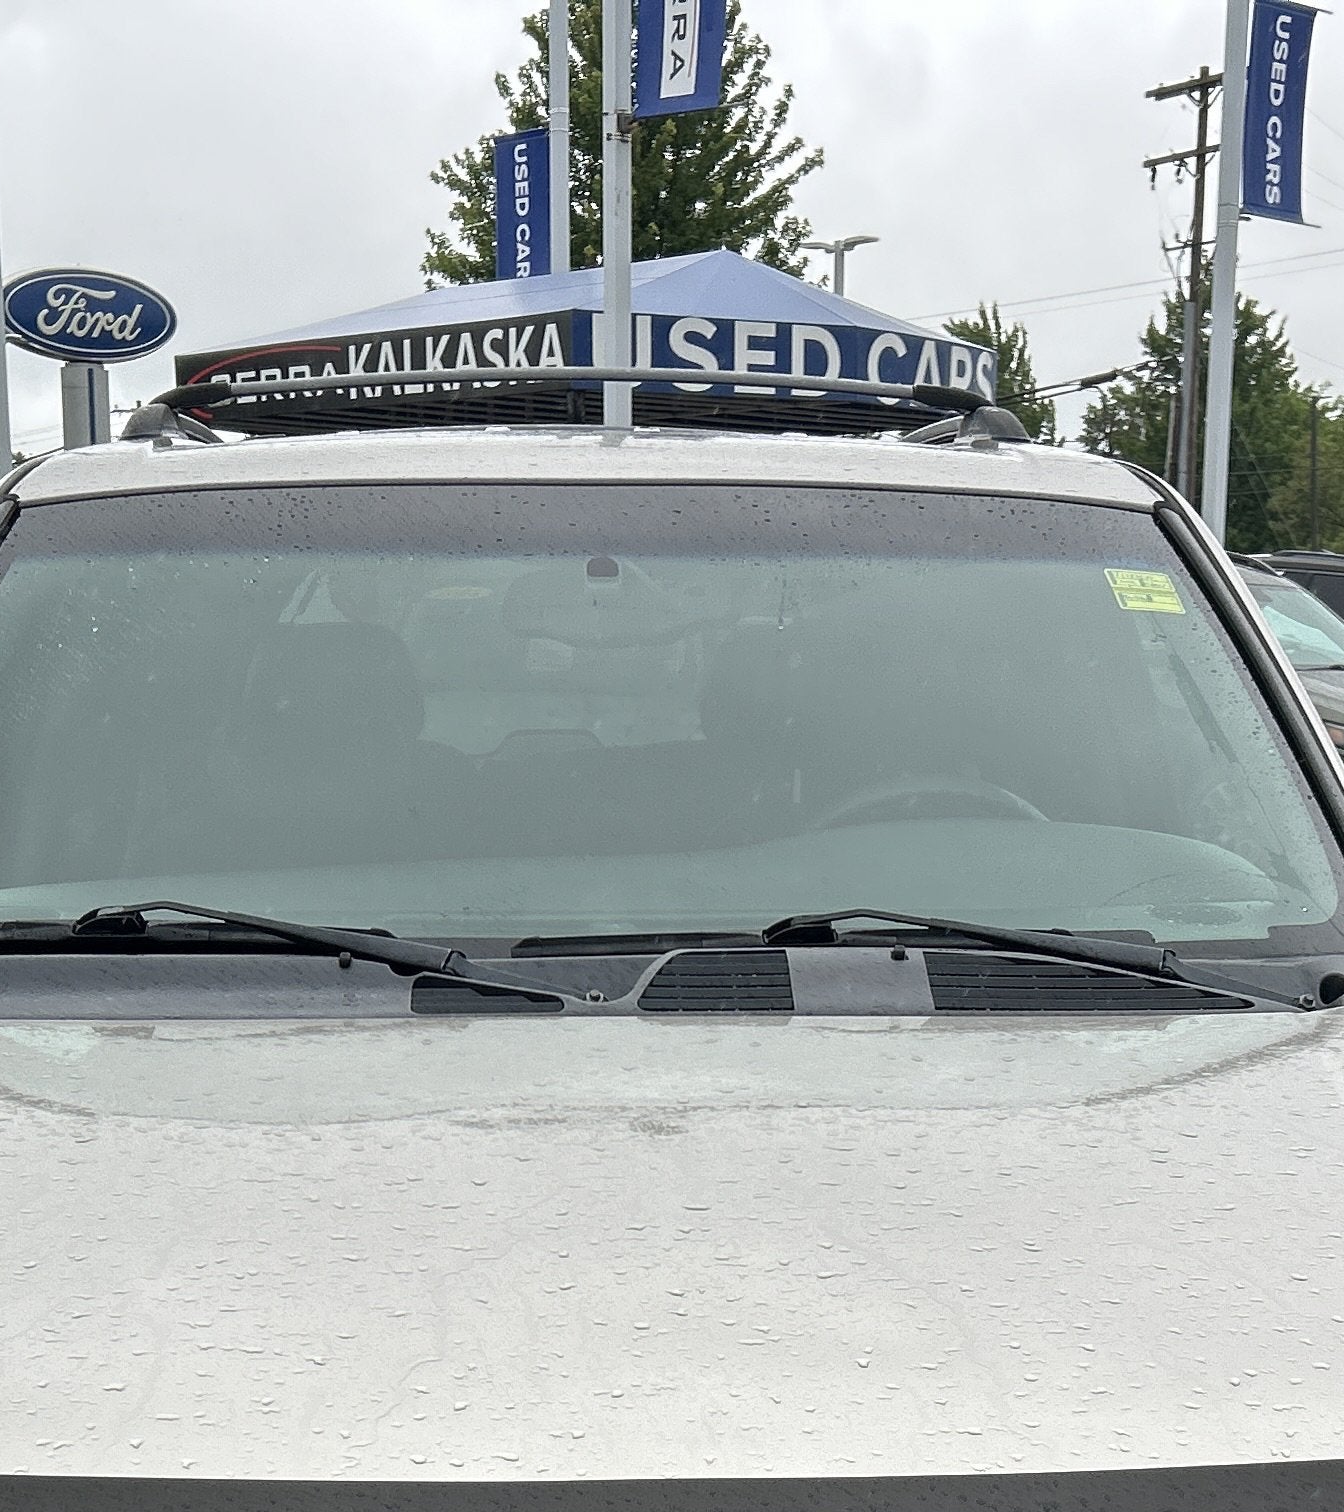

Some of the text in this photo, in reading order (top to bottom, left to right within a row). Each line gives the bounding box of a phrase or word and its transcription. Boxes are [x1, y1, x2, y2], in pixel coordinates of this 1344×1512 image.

[669, 0, 688, 80] RA
[1265, 15, 1293, 206] USED CARS
[513, 143, 529, 217] USED
[36, 283, 144, 342] Ford
[348, 323, 565, 400] KALKASKA
[591, 312, 842, 398] USED
